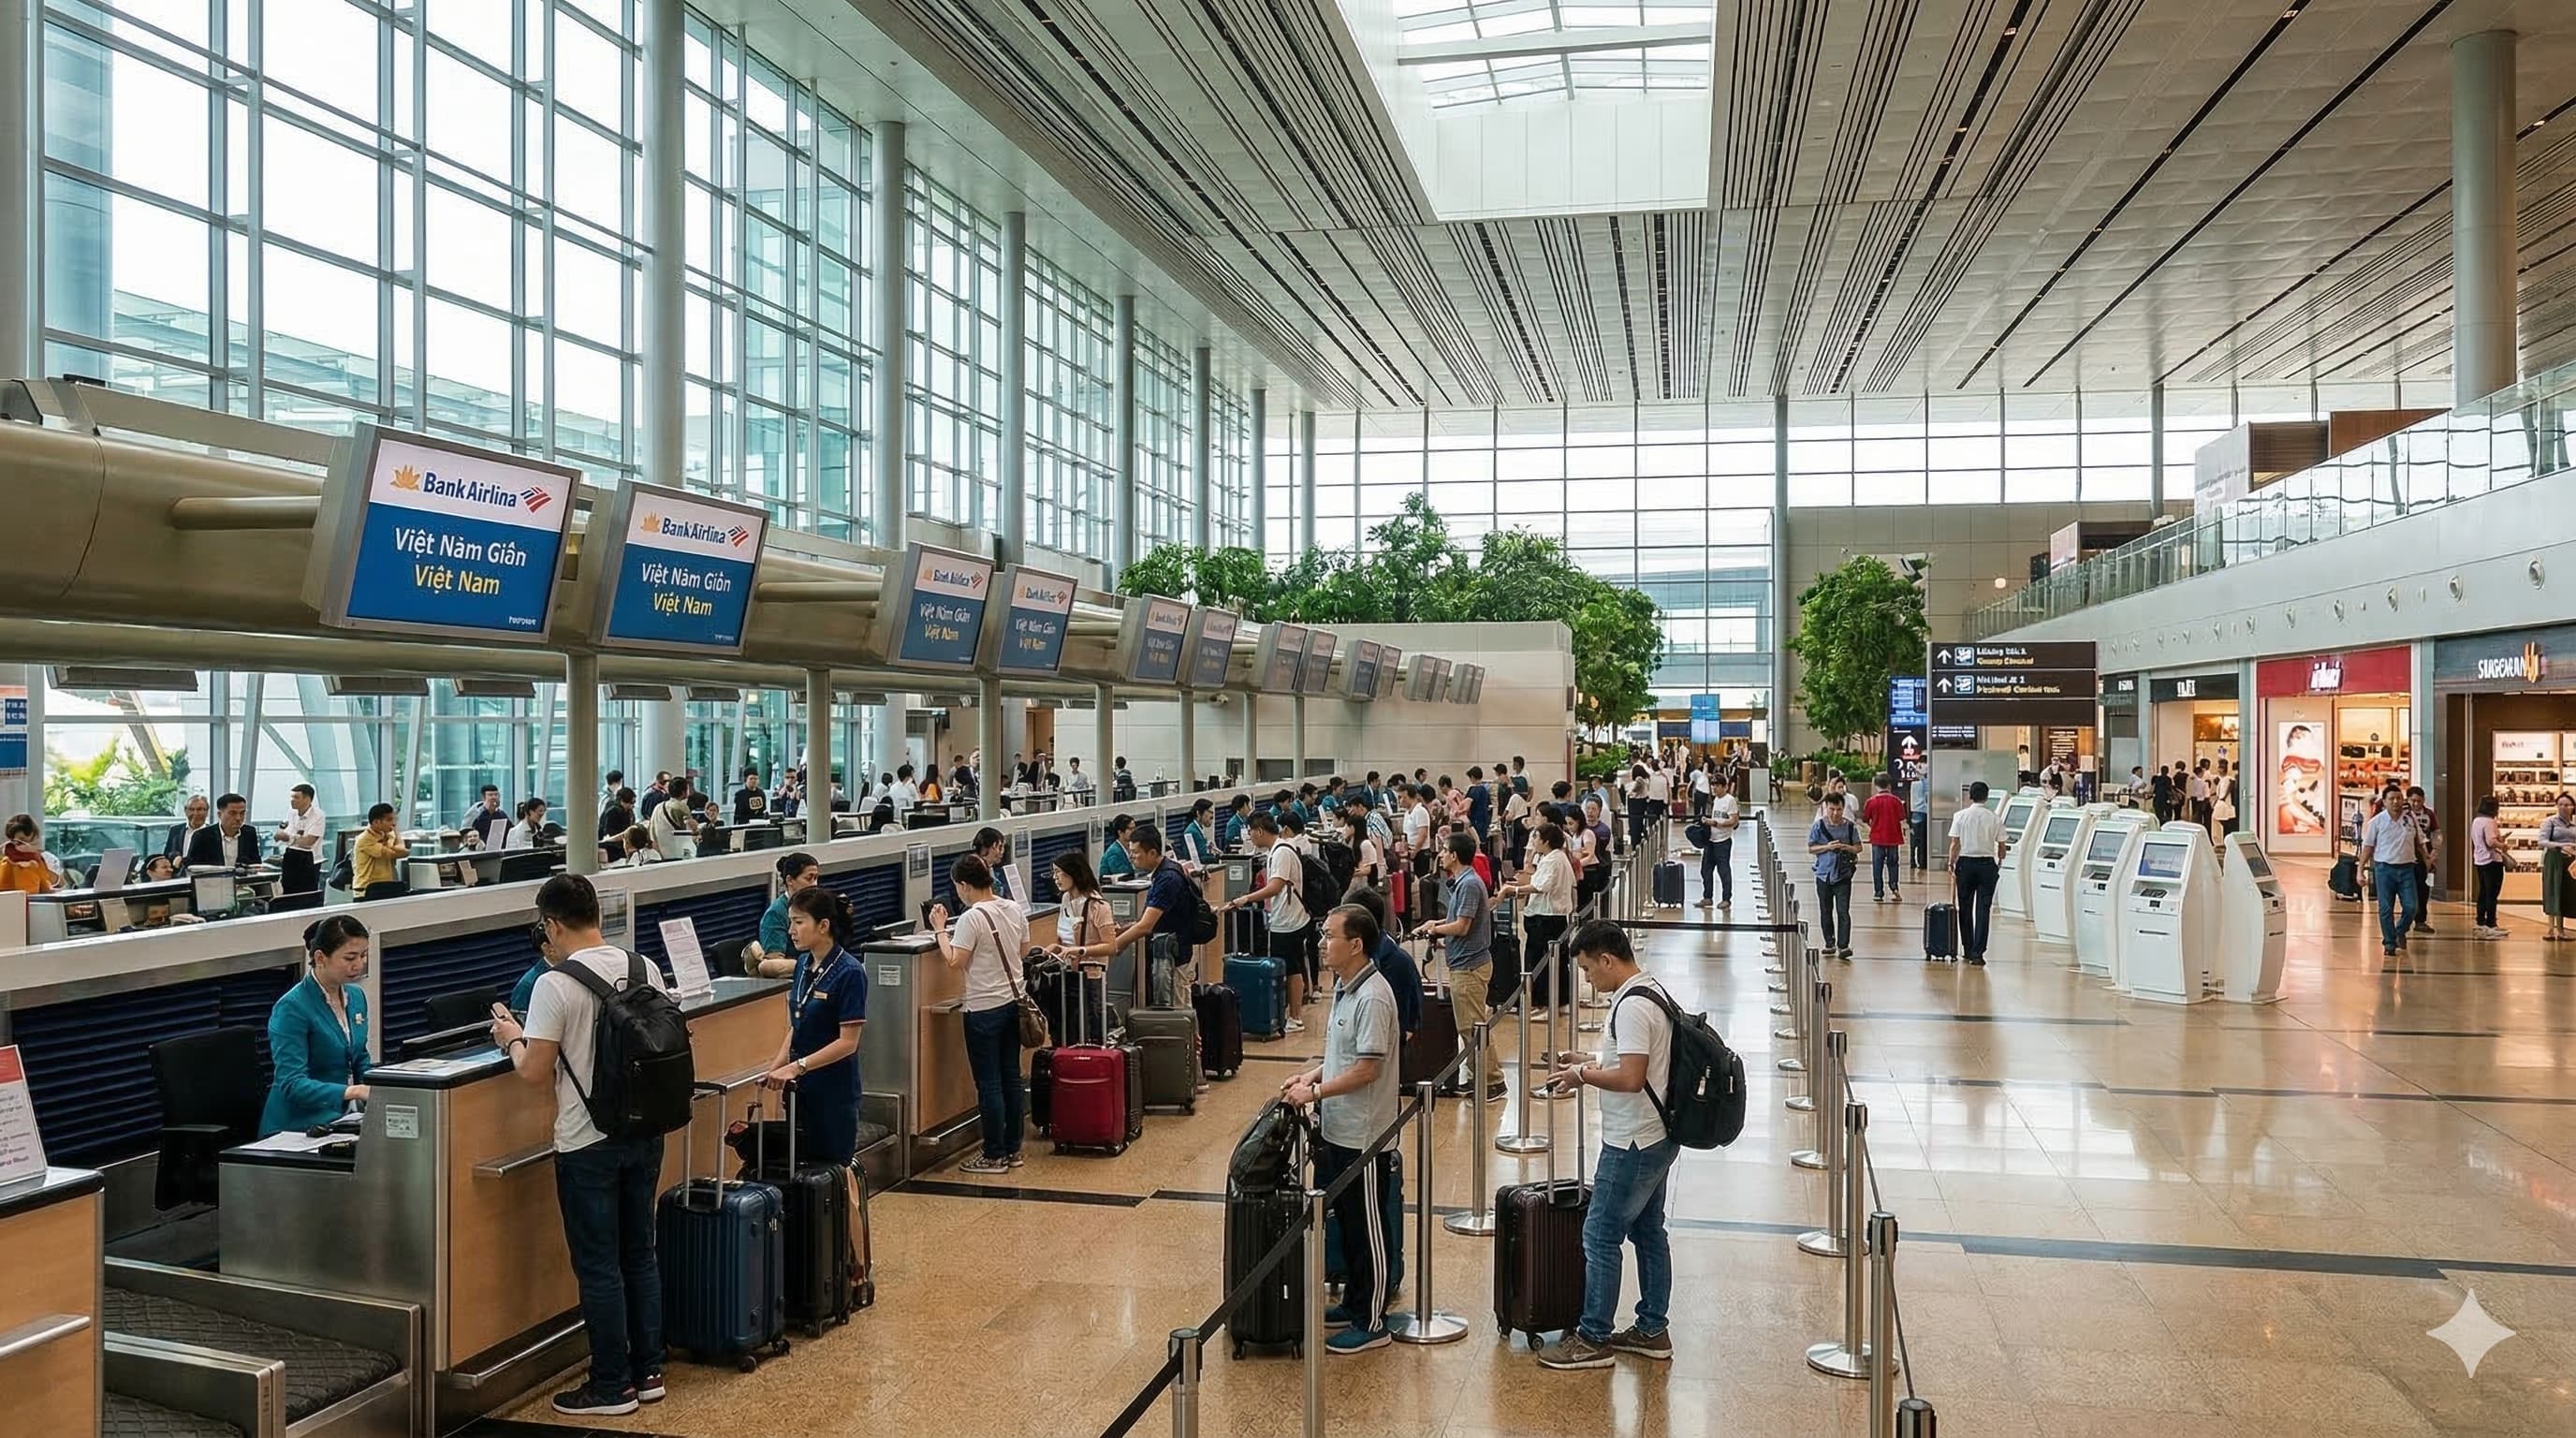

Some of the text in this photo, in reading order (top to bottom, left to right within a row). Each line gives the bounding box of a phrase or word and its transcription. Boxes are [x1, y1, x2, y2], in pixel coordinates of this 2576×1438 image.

[395, 527, 435, 559] Việt
[415, 564, 500, 595] Việt Nam
[641, 562, 668, 588] Việt
[682, 595, 712, 616] Nam
